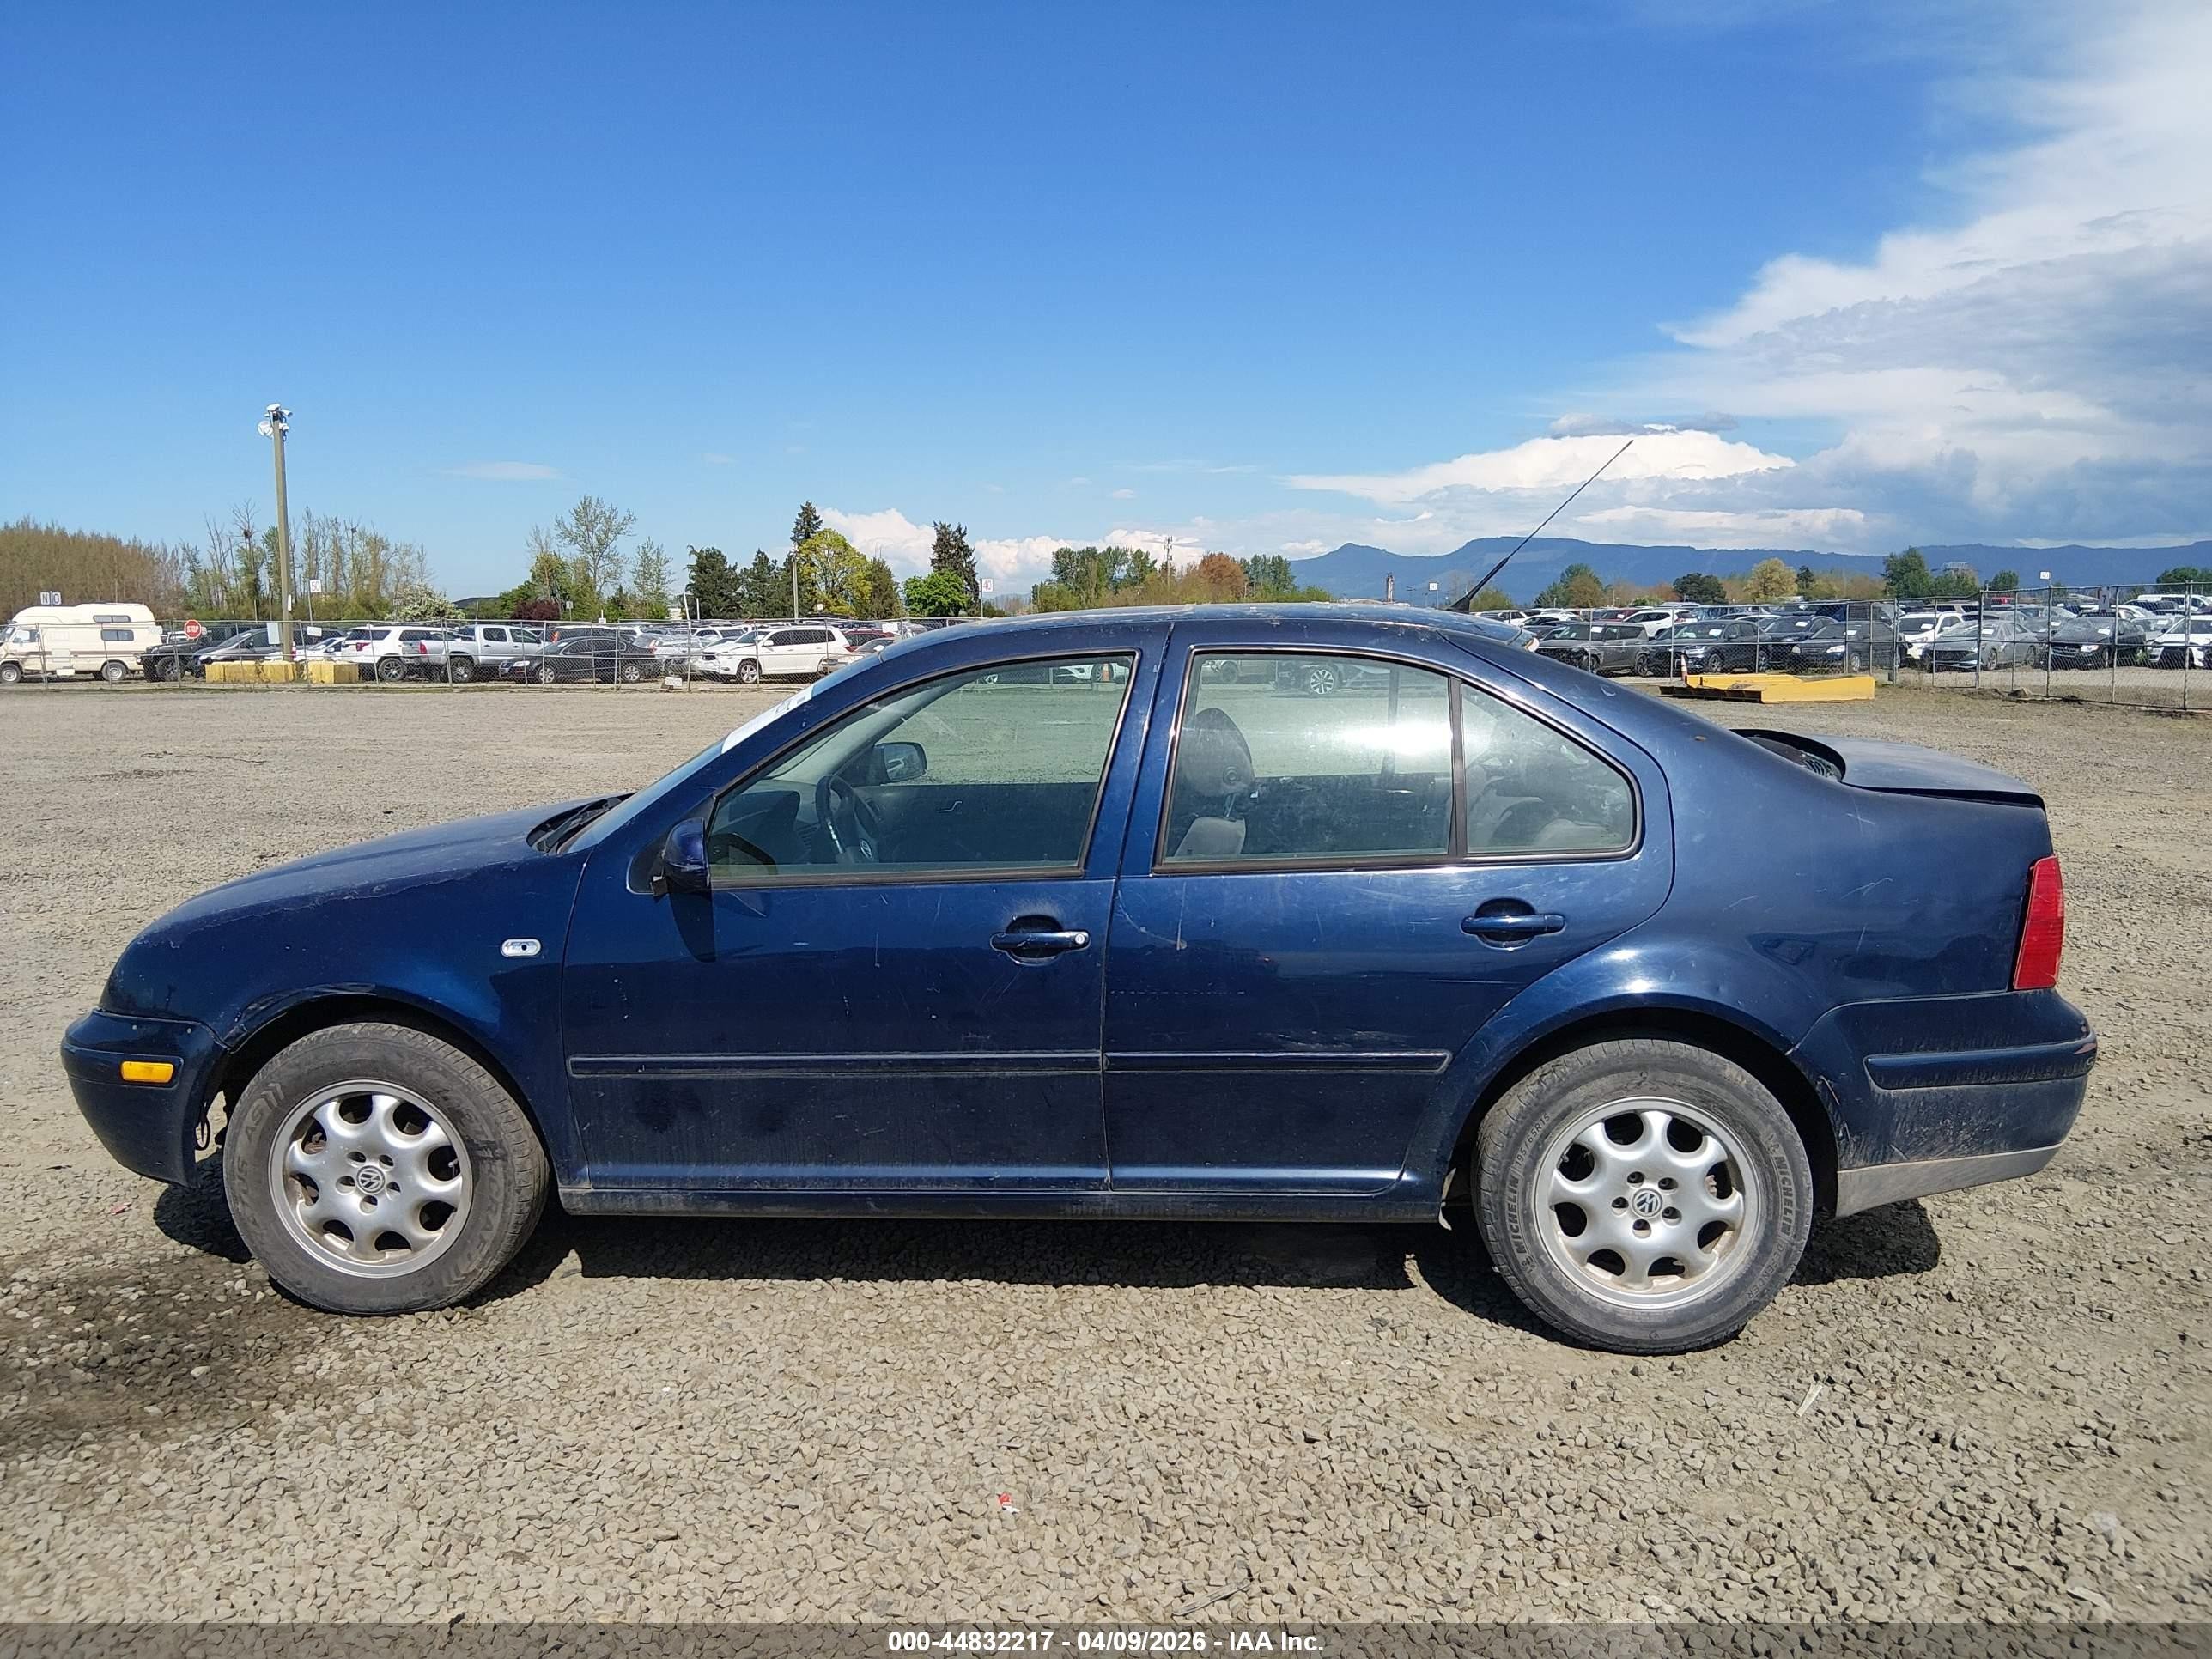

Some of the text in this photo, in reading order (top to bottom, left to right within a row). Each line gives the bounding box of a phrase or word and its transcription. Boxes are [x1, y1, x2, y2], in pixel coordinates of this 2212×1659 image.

[310, 581, 320, 592] 50
[982, 580, 992, 591] 40
[1506, 1113, 1550, 1255] MICHELIN 195/65R15
[1747, 1156, 1795, 1299] MICHELIN DEFENDER
